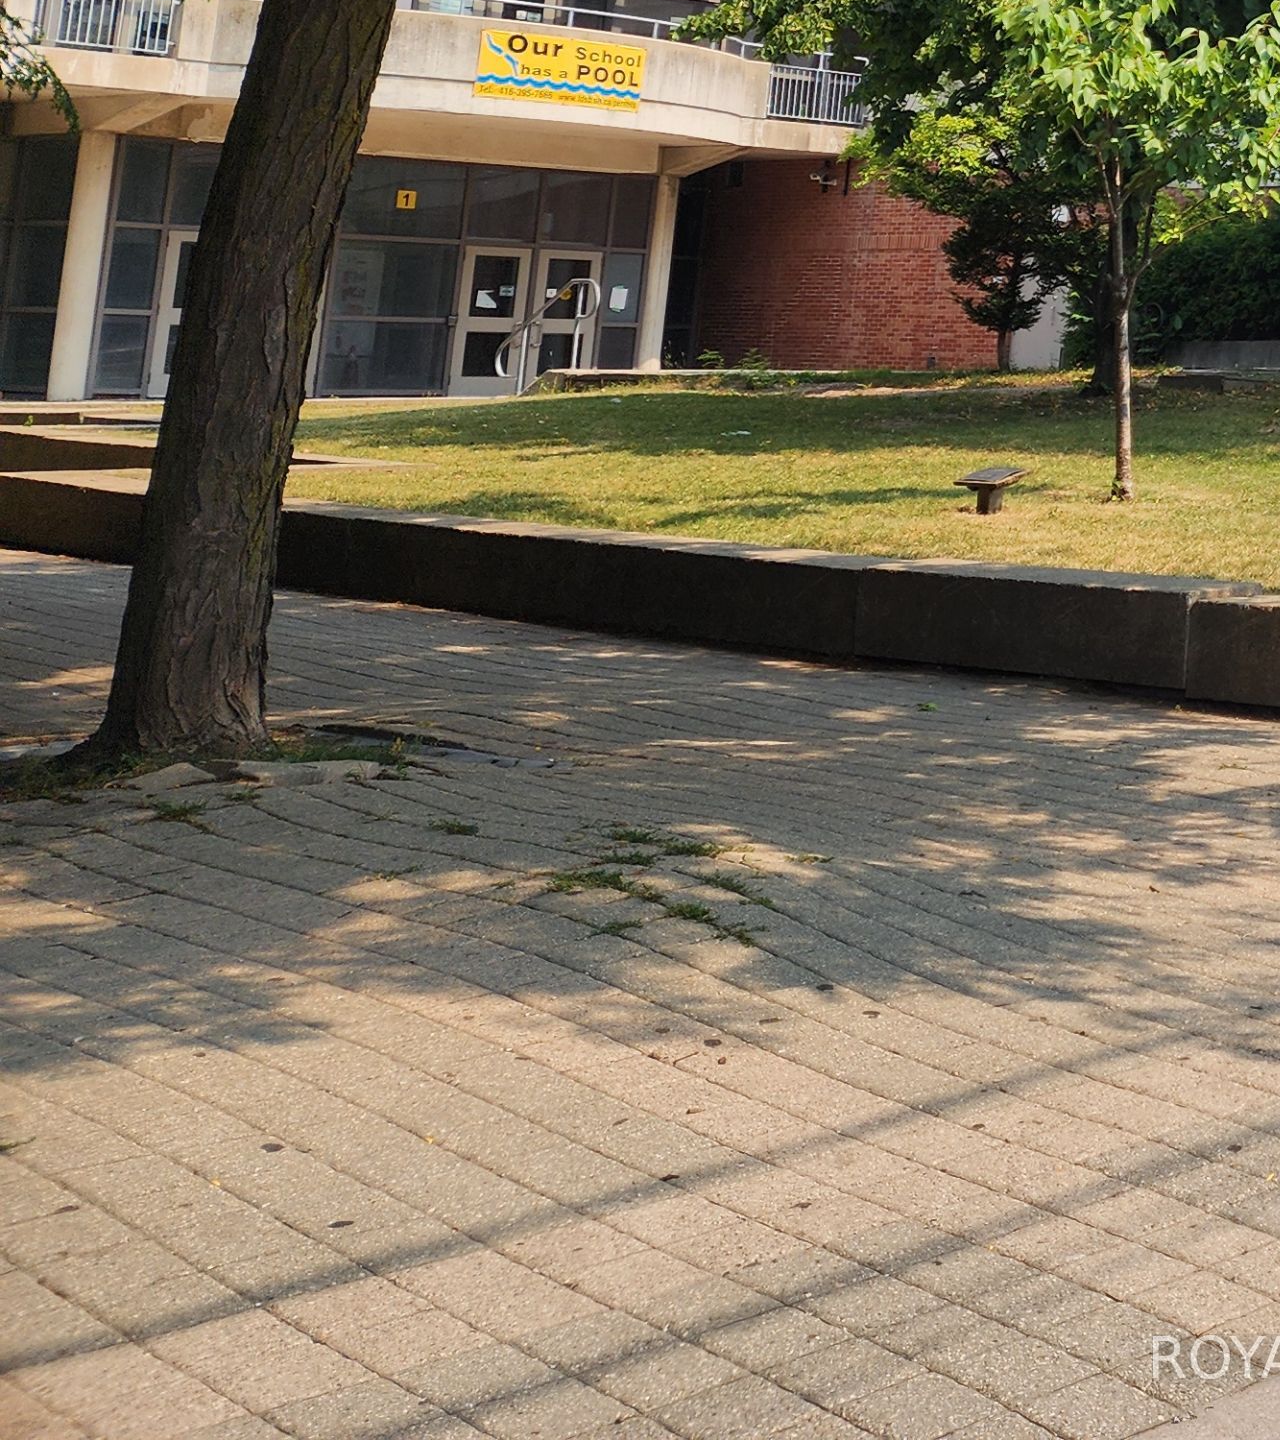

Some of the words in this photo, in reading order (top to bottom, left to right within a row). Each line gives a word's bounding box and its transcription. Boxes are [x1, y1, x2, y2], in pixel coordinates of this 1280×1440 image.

[508, 34, 563, 57] Our
[575, 47, 642, 68] School
[520, 64, 552, 77] has
[559, 70, 568, 79] a
[577, 65, 639, 87] POOL
[402, 193, 410, 207] 1
